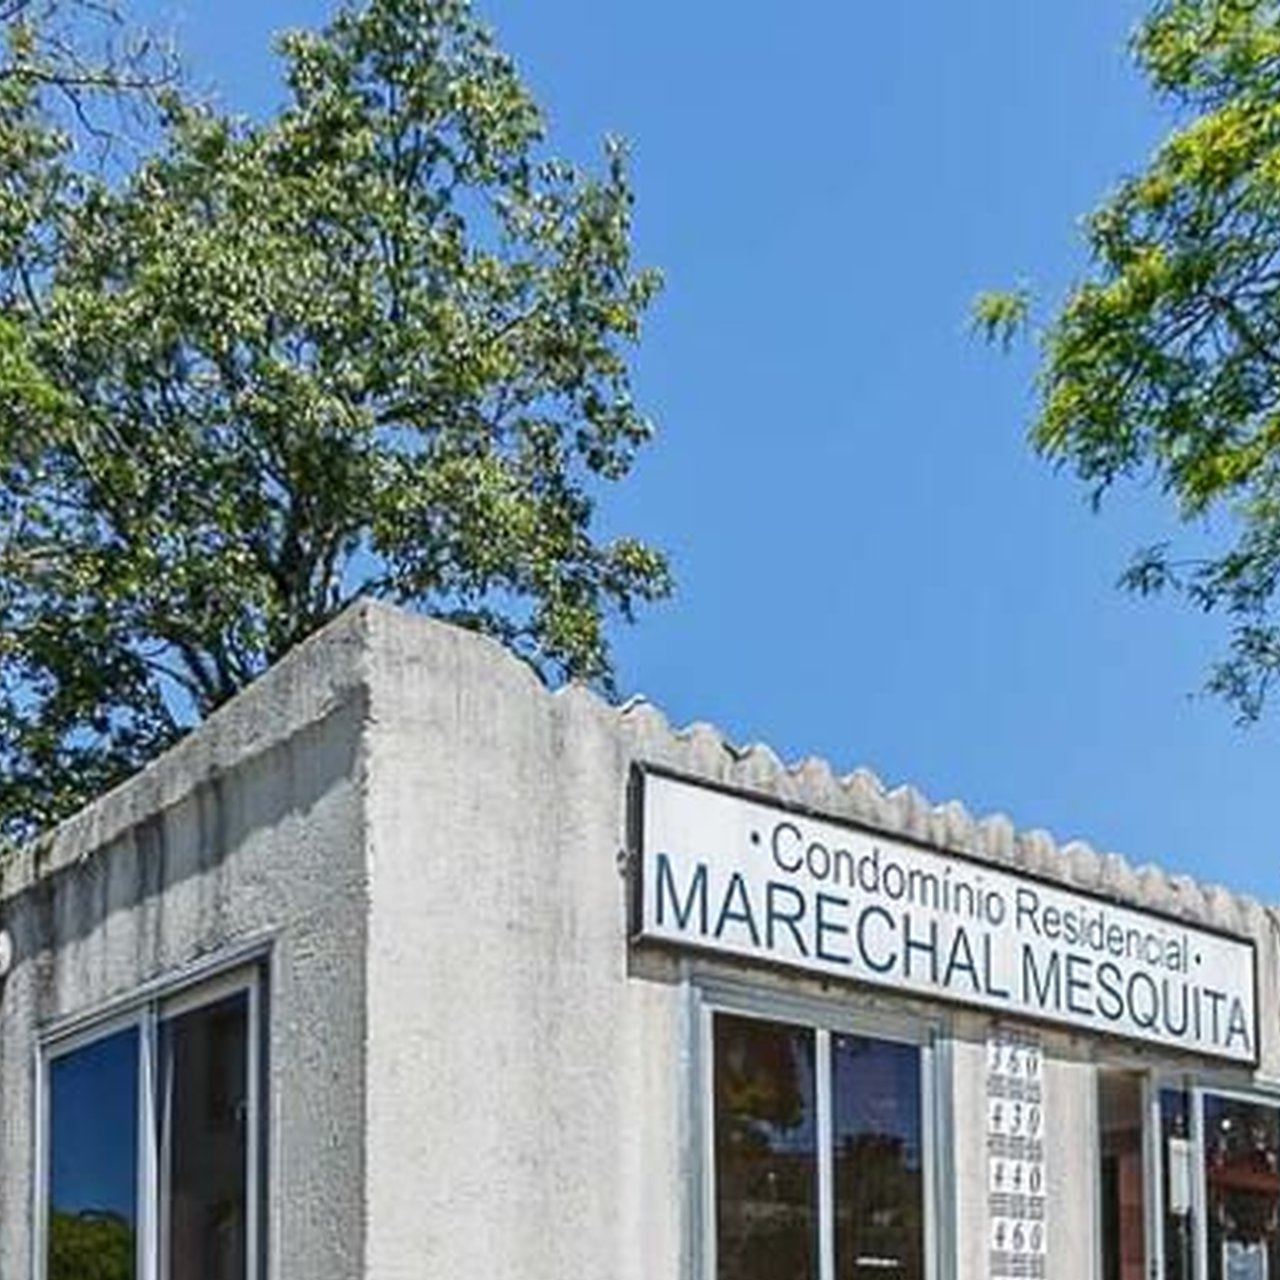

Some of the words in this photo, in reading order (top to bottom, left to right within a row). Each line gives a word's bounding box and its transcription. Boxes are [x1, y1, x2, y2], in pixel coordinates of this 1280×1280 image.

[771, 822, 1006, 926] Condomínio
[1016, 888, 1188, 973] Residencial
[656, 852, 1010, 1001] MARECHAL
[1021, 942, 1251, 1053] MESQUITA
[993, 1104, 1041, 1136] 430
[994, 1163, 1042, 1193] 440
[995, 1221, 1043, 1250] 460
